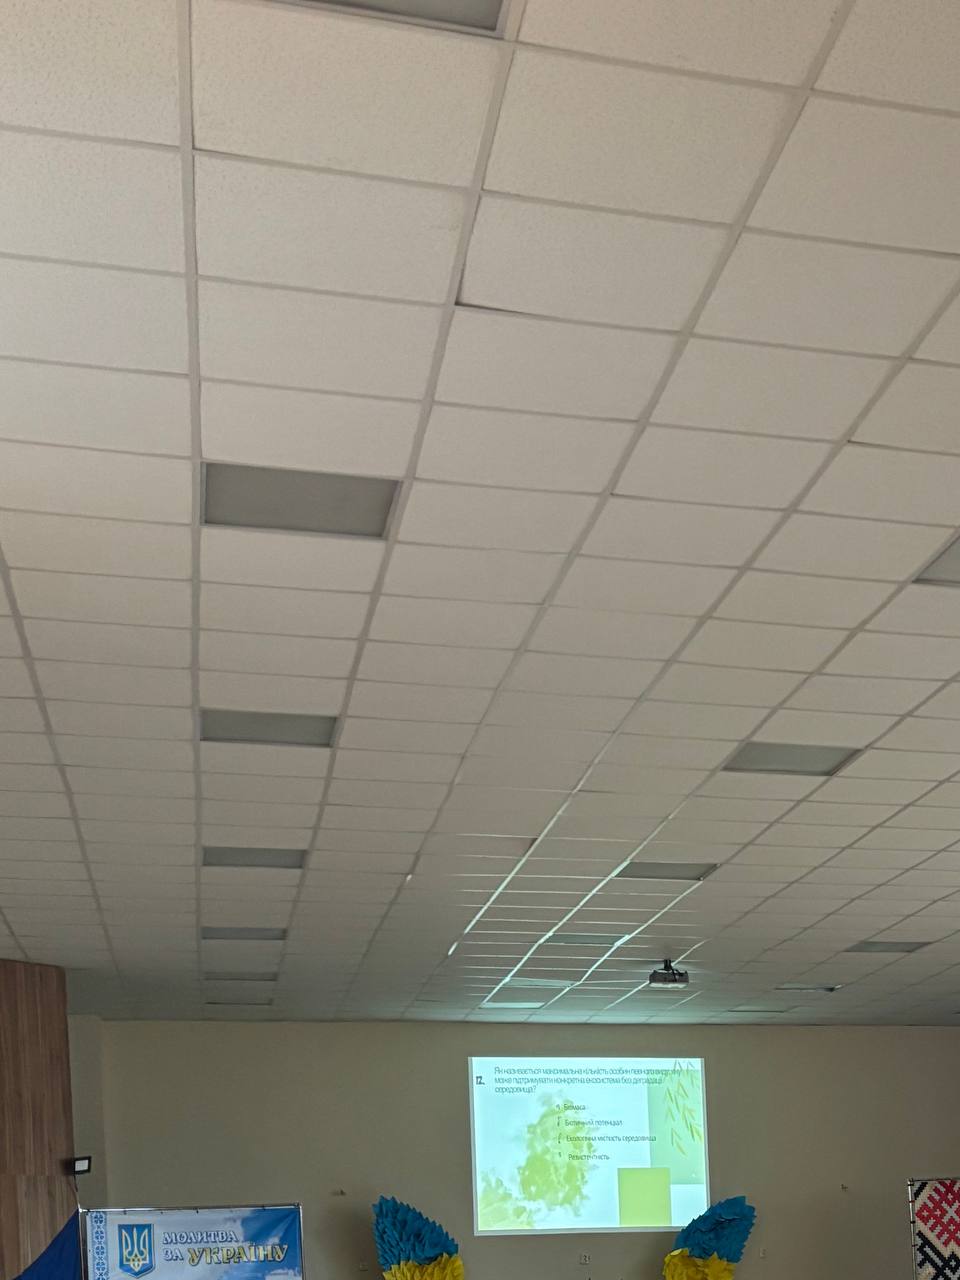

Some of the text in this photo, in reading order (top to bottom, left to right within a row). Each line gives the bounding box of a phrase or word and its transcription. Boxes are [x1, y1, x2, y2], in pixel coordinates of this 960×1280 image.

[162, 1230, 239, 1245] МОЛИТВА
[163, 1241, 288, 1267] ЗА УКРАЇНУ
